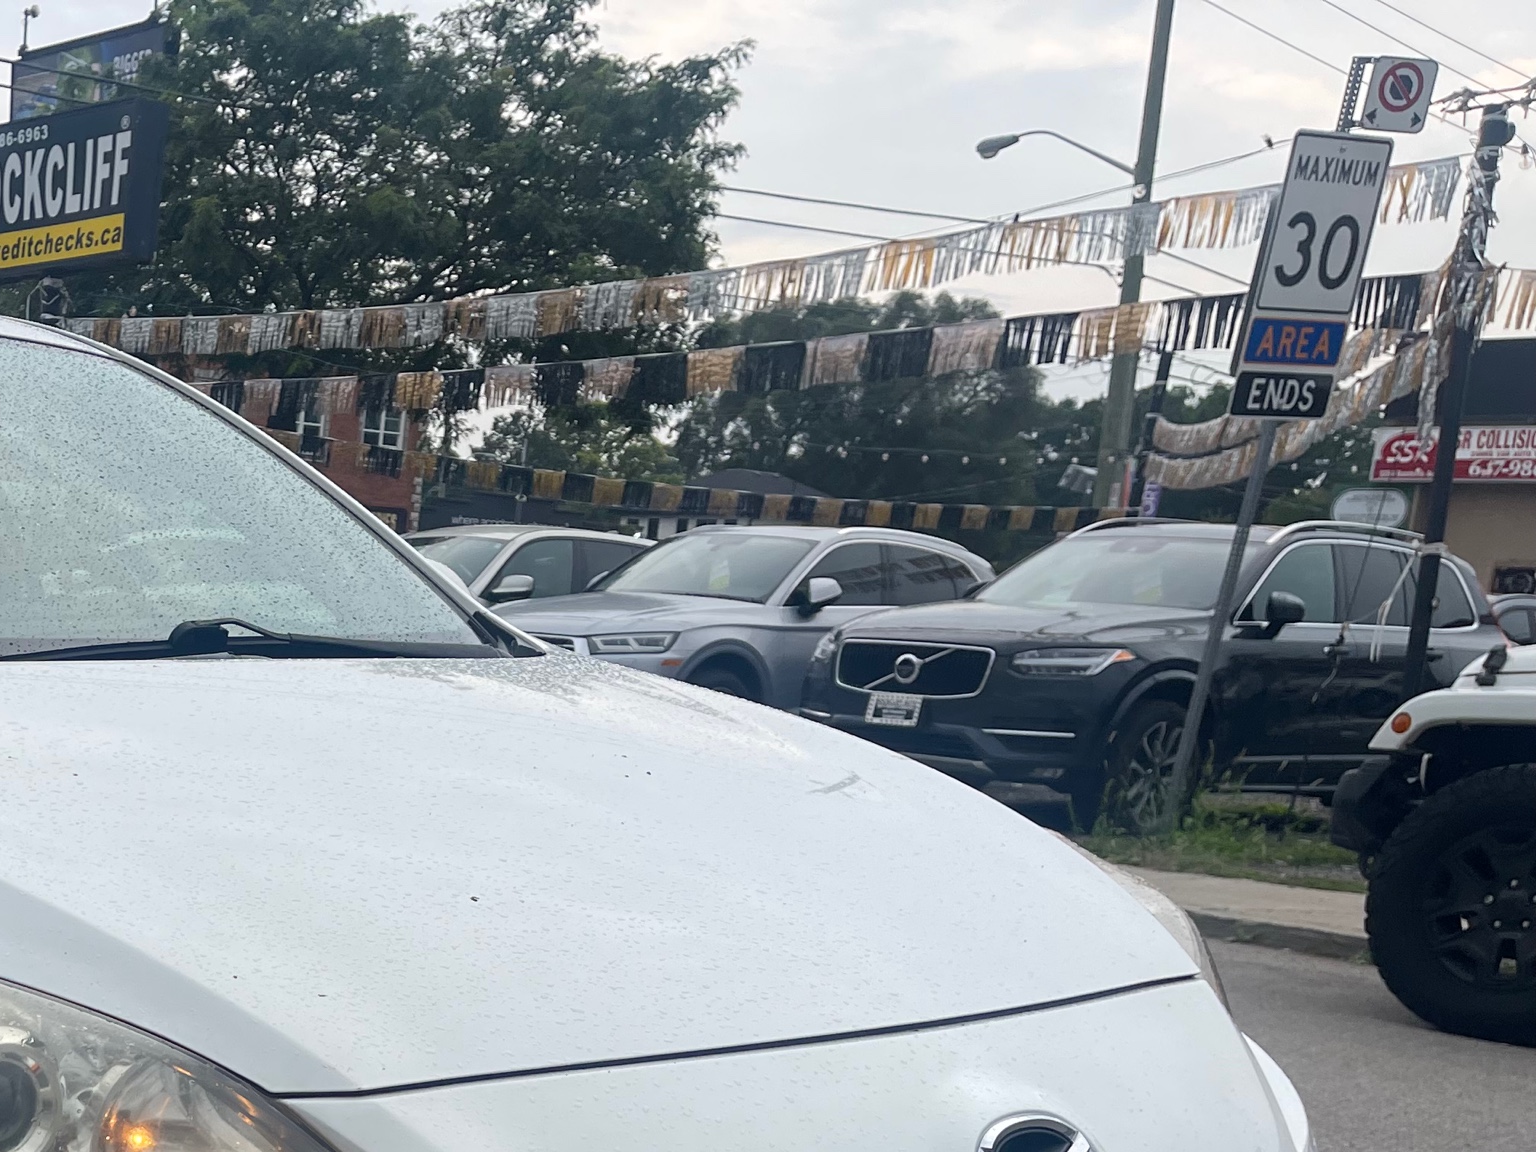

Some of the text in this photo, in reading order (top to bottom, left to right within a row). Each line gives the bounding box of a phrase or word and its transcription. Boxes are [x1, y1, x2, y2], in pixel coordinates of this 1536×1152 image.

[1294, 154, 1381, 187] MAXIMUM
[1274, 210, 1360, 290] 30
[1257, 325, 1331, 362] AREA
[1246, 377, 1317, 412] ENDS
